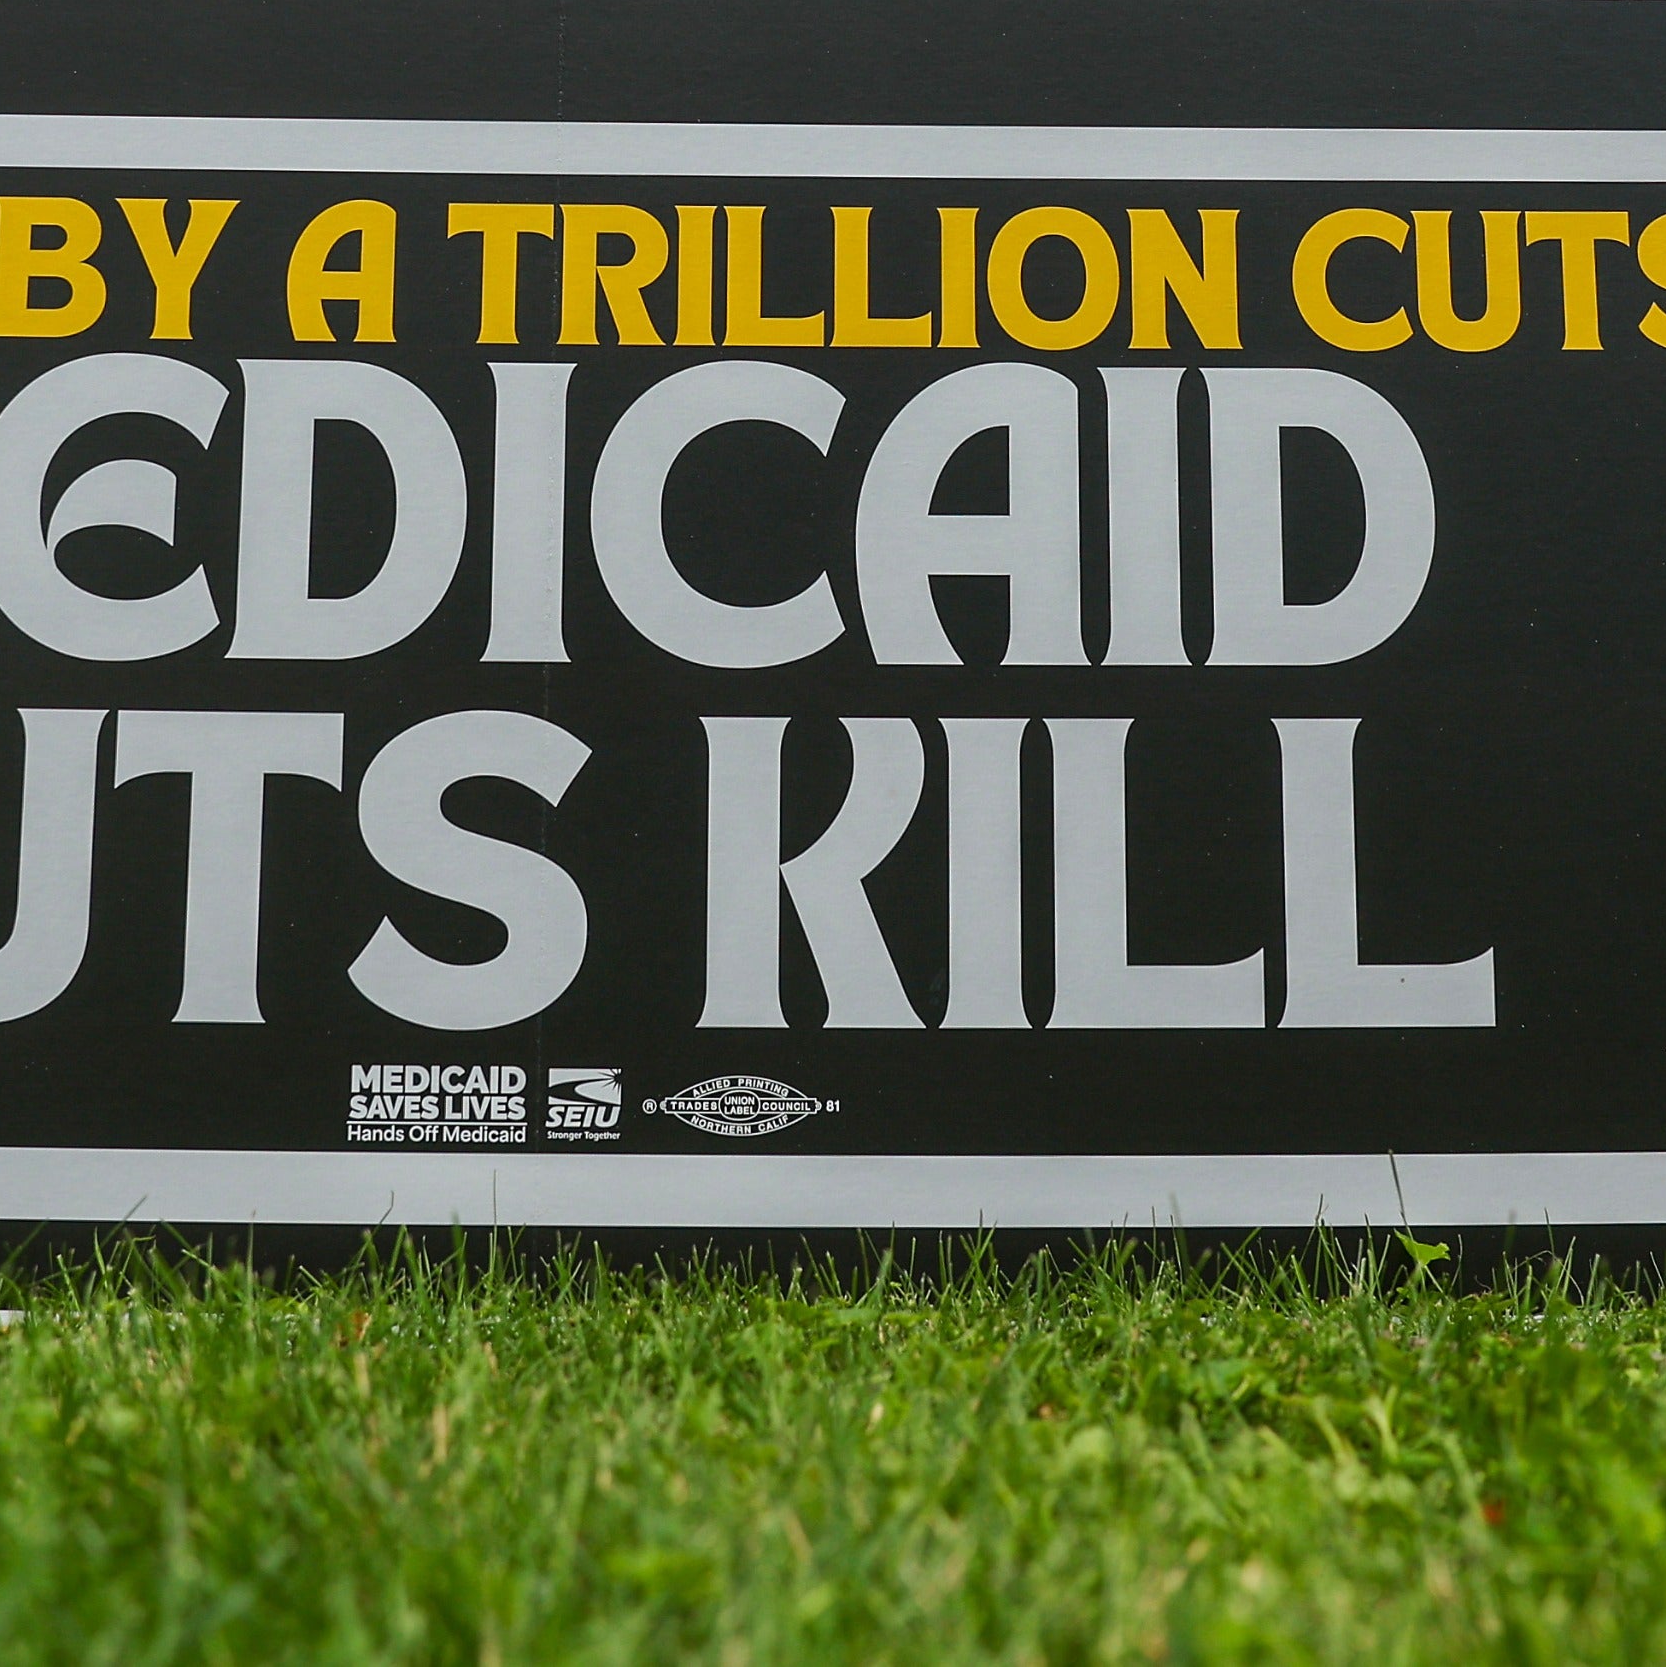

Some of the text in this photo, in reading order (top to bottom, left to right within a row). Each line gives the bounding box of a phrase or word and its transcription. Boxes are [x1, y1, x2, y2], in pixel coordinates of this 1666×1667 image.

[285, 198, 398, 343] A
[446, 202, 1245, 352] TRILLION
[695, 715, 1497, 1031] KILL
[350, 1063, 527, 1095] MEDICAID
[693, 1077, 790, 1098] ALLIED PRINTING
[348, 1095, 527, 1121] SAVES LIVES
[670, 1100, 718, 1111] TRADES
[762, 1101, 811, 1111] COUNCIL
[825, 1100, 840, 1112] 81
[723, 1096, 755, 1106] UNION
[723, 1105, 755, 1115] LABEL
[545, 1105, 621, 1128] SEIU
[690, 1115, 789, 1134] NORTHERN CALIF
[347, 1124, 527, 1143] Hands Off Medicaid
[546, 1130, 621, 1142] Stronger Together
